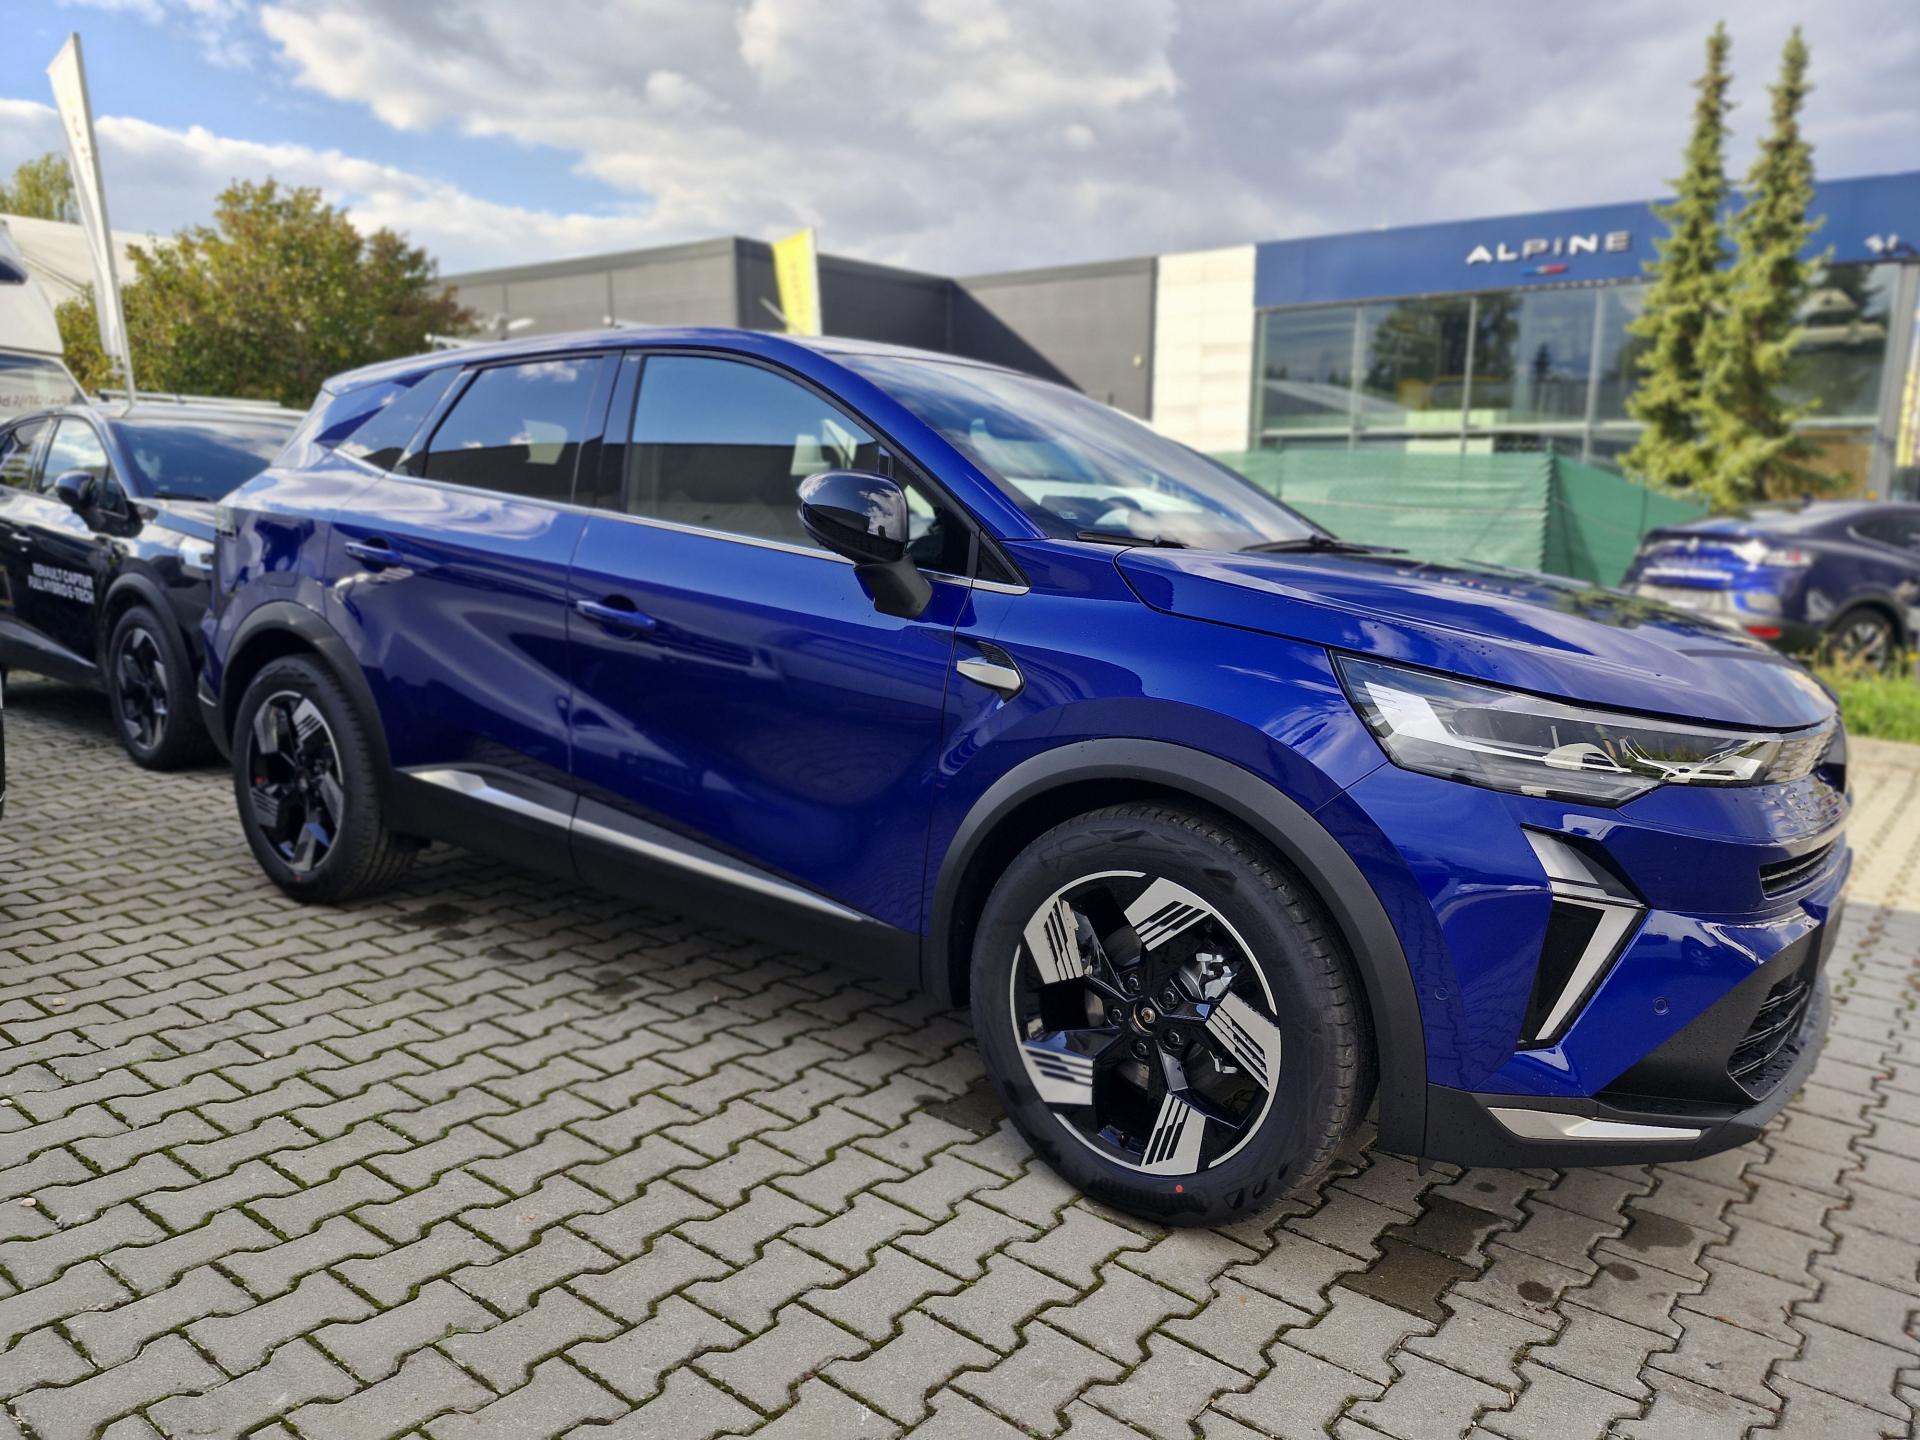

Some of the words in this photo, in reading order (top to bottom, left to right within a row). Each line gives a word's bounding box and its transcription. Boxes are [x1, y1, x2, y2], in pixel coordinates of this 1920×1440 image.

[1466, 230, 1630, 265] ALPINE
[32, 562, 62, 584] RENAULT
[63, 570, 94, 591] CAPTUR
